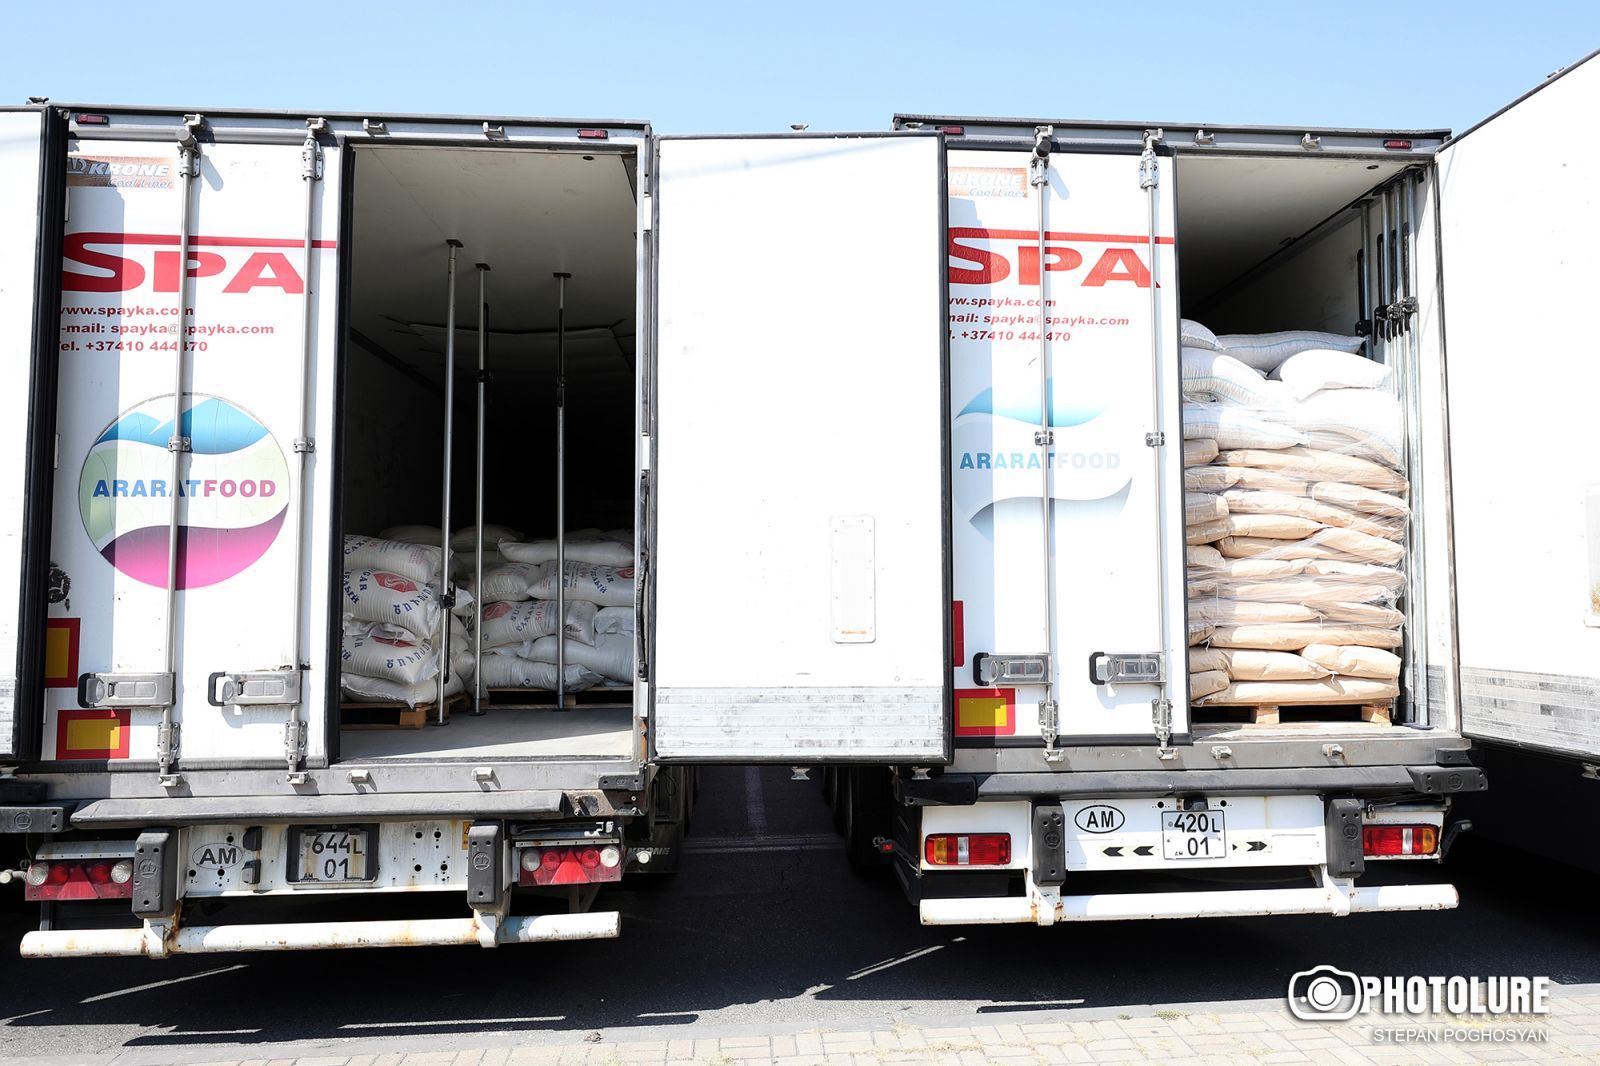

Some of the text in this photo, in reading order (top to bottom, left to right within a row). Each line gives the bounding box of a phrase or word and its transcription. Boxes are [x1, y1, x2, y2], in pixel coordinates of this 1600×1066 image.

[89, 163, 169, 177] KRONE
[949, 297, 1056, 308] ww.spayka.com
[61, 323, 105, 333] -mail:
[961, 330, 1013, 340] +37410
[60, 341, 80, 351] el.
[86, 341, 144, 351] +37410
[959, 452, 1121, 469] ARARATFOOD
[93, 479, 276, 497] ARARATFOOD
[1086, 810, 1114, 828] AM
[1173, 813, 1220, 833] 420L
[311, 833, 363, 854] 644L
[1187, 836, 1210, 856] 01
[199, 847, 237, 864] AM
[324, 858, 349, 879] 01
